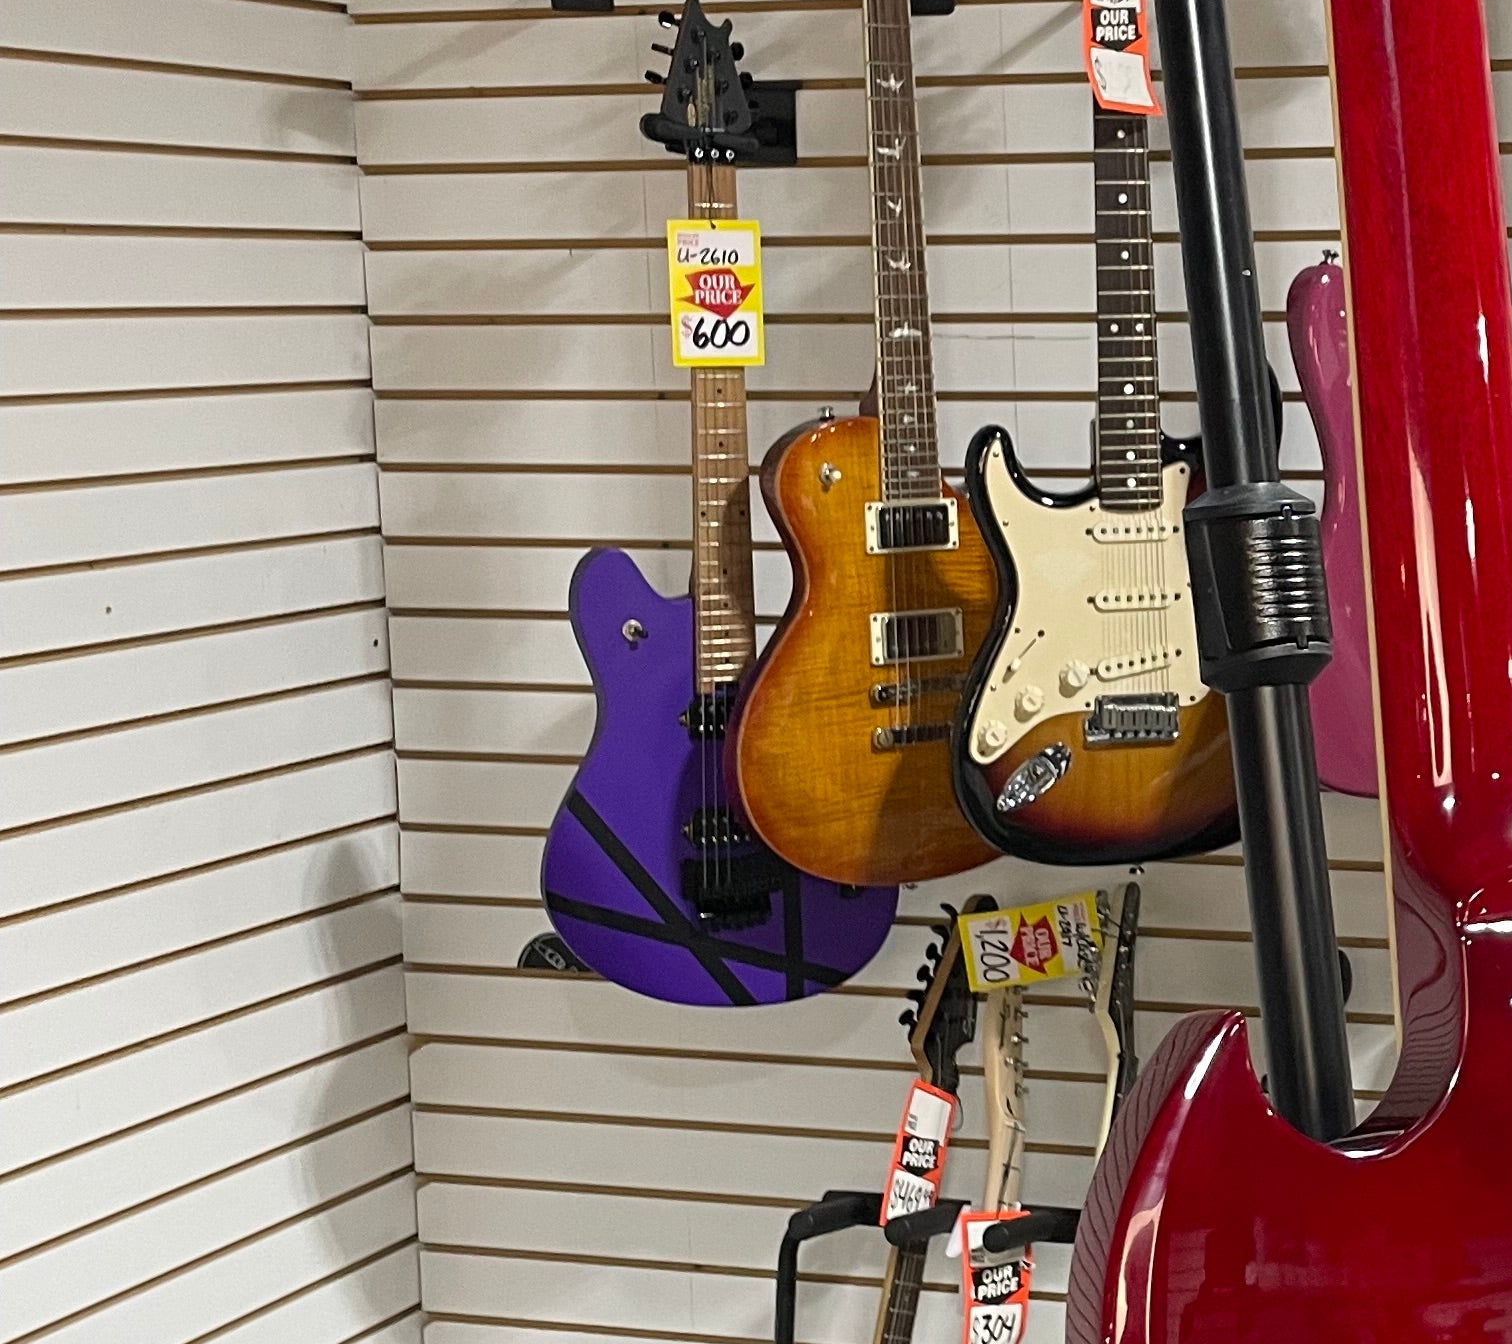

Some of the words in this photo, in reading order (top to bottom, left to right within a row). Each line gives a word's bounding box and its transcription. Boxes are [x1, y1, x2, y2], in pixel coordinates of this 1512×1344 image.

[1100, 9, 1130, 26] OUR
[1095, 25, 1137, 42] PRICE
[677, 247, 739, 265] U-2610
[699, 273, 735, 290] OUR
[694, 289, 743, 306] PRICE
[681, 315, 751, 350] $600
[908, 1138, 935, 1155] OUR
[902, 1151, 937, 1169] PRICE
[981, 1264, 1013, 1284] OUR
[977, 1277, 1019, 1301] PRICE
